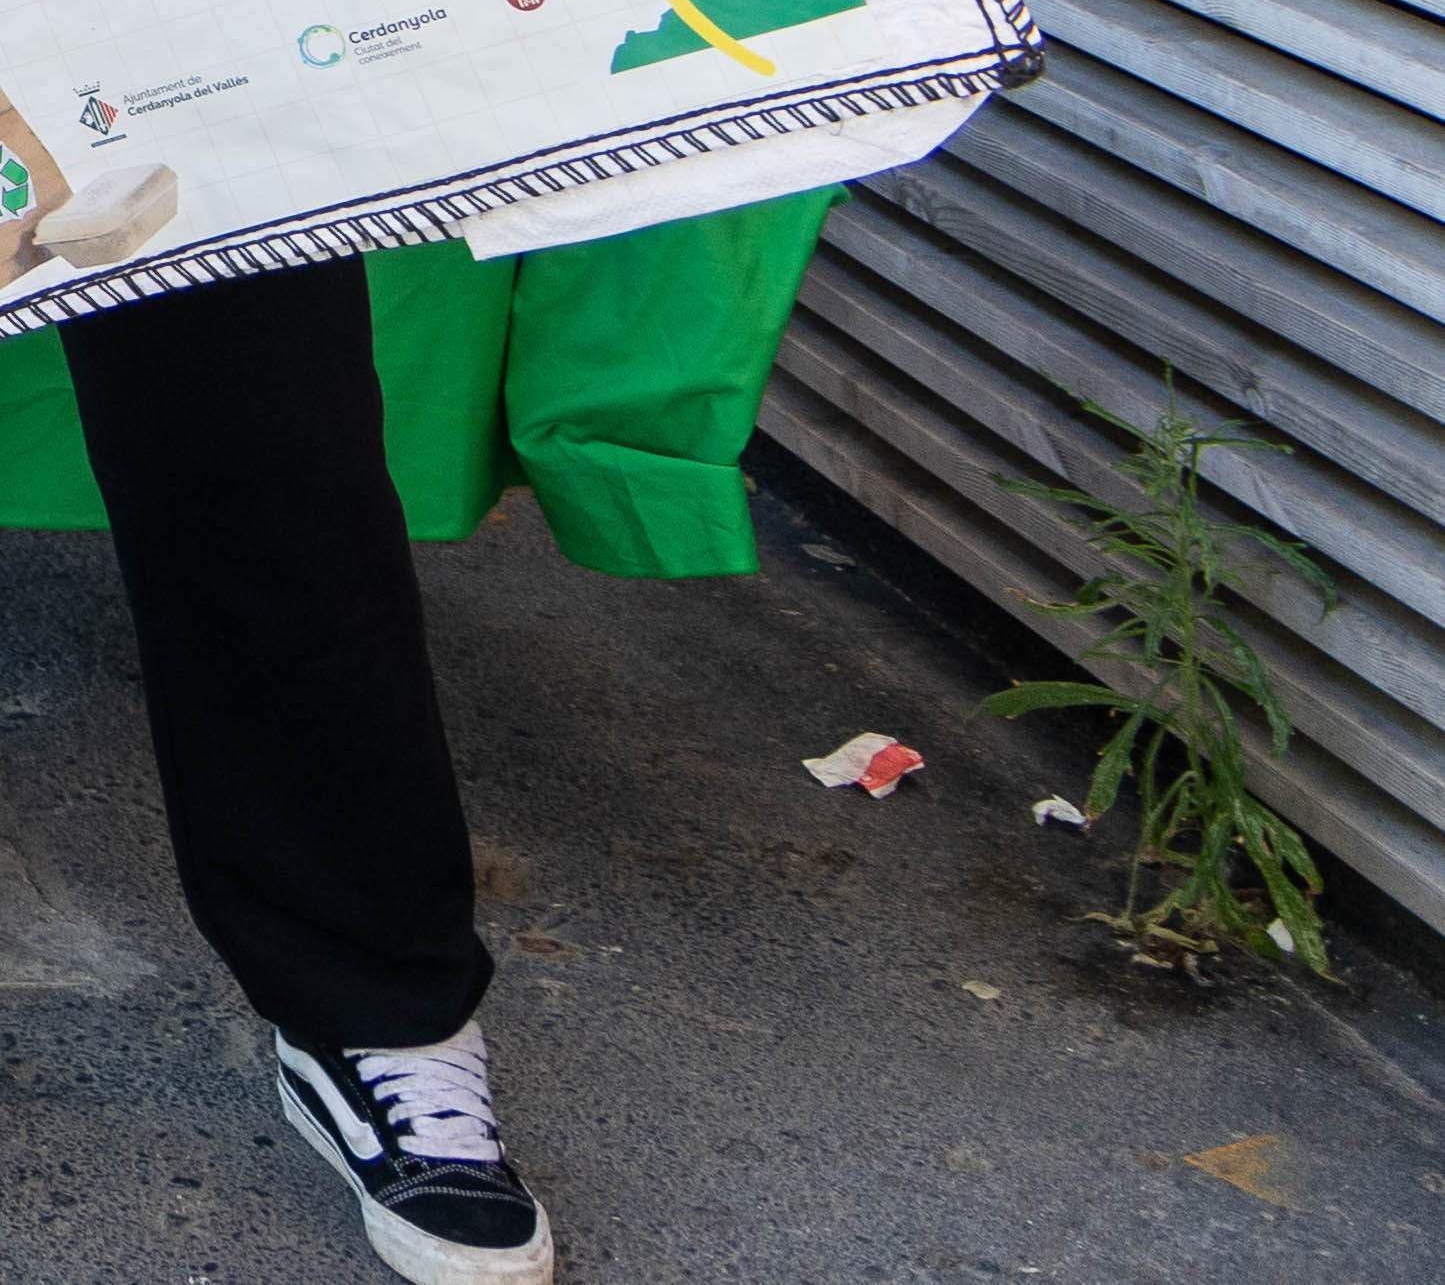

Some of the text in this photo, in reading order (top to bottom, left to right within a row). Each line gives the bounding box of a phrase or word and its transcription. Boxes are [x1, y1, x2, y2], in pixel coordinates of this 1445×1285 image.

[348, 5, 448, 45] Cerdanyola
[354, 35, 404, 57] Ciutat del
[122, 75, 202, 105] Ajuntament de
[126, 93, 192, 117] Cerdanyola
[194, 83, 214, 99] del
